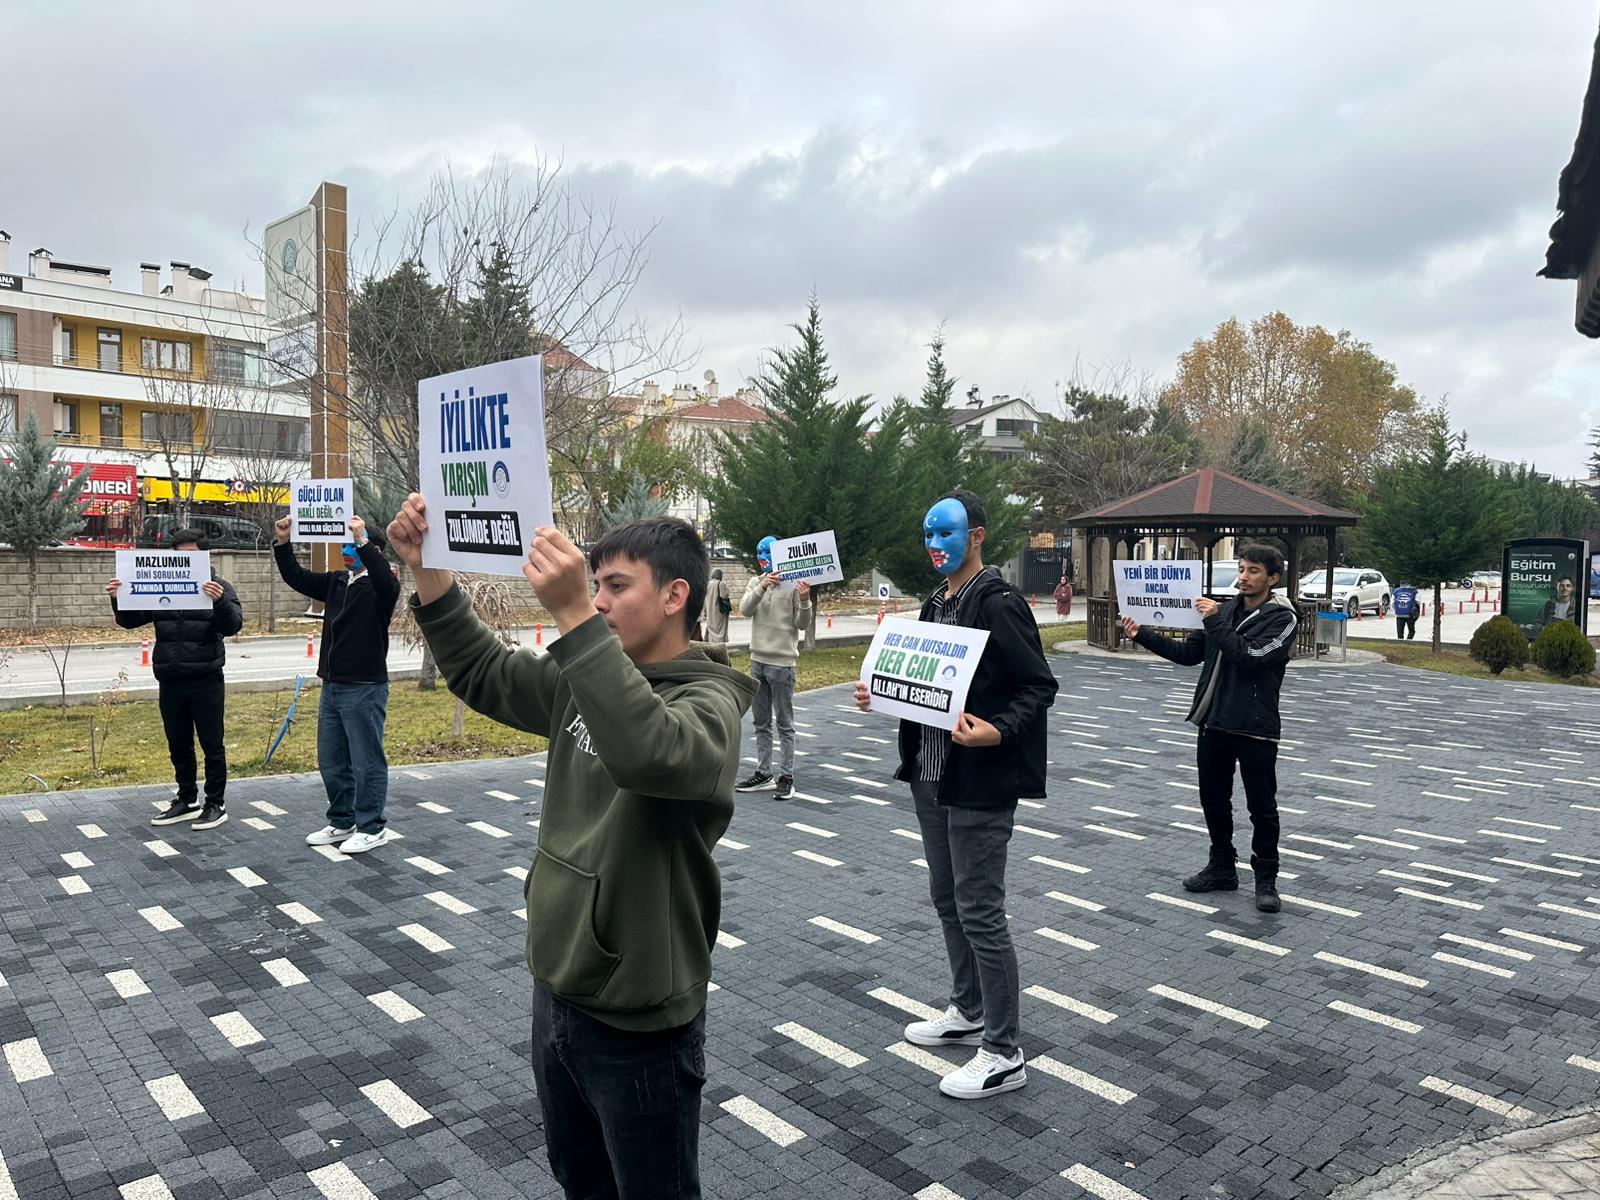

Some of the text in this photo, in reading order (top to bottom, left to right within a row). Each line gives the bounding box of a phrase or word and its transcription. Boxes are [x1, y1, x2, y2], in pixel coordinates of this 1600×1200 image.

[441, 387, 511, 454] İYİLİKTE
[441, 461, 489, 508] YARIŞIN
[298, 485, 344, 506] GÜÇLÜ OLAN
[298, 504, 333, 519] HAKLI DEĞİL
[447, 513, 520, 546] ZULÜMDE DEĞİL
[787, 541, 818, 559] ZULÜM
[135, 556, 190, 568] MAZLUMUN
[1510, 559, 1556, 571] Eğitim
[136, 569, 191, 579] DİNİ SORULMAZ
[1123, 565, 1191, 580] YENİ BİR DÜNYA
[1510, 572, 1552, 582] Bursu
[133, 583, 195, 592] YANINDA DURULUR
[1145, 583, 1169, 594] ANCAK
[1127, 596, 1192, 609] ADALETLE KURULUR
[884, 632, 968, 659] HER CAN KUTSALDIR
[874, 648, 940, 682] HER CAN
[872, 678, 949, 710] ALLAH'IN ESERİDİR
